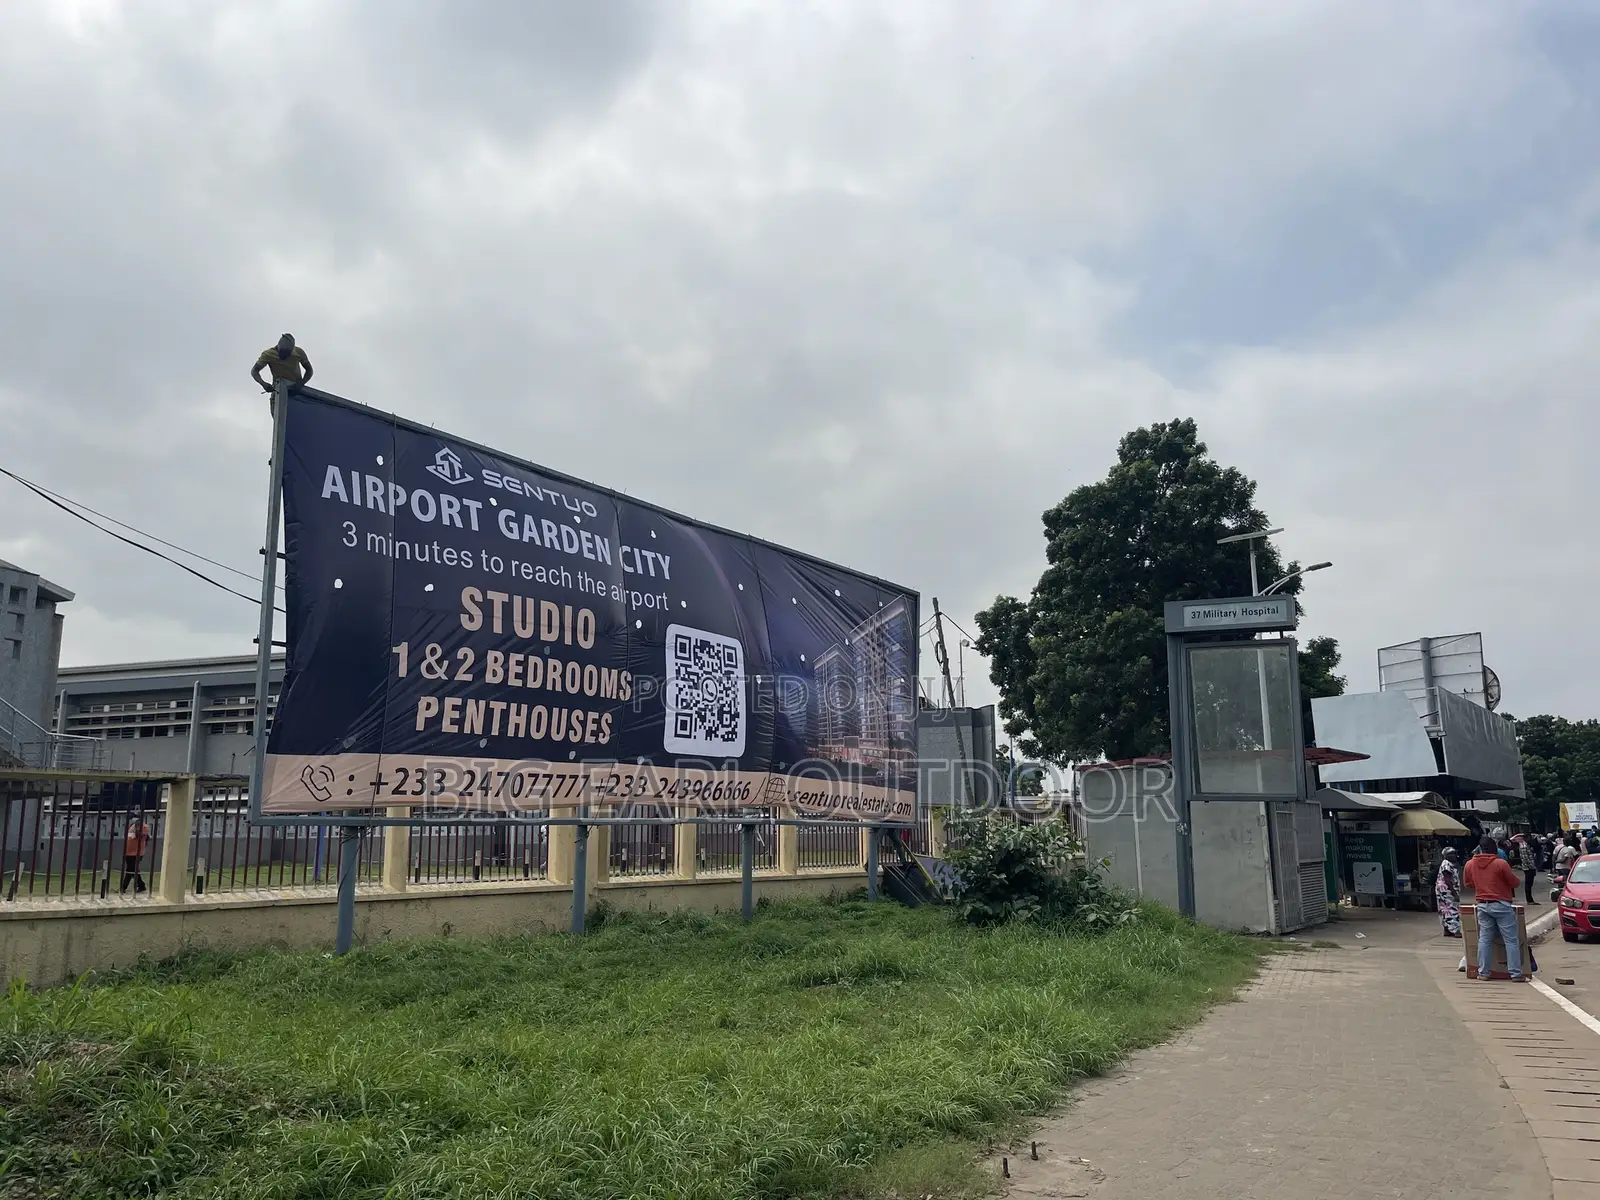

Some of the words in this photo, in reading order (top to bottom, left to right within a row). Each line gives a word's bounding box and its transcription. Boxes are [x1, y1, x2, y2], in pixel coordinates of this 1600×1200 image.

[481, 469, 598, 518] SENTUO
[321, 465, 482, 532] AIRPORT
[498, 508, 612, 566] GARDEN
[620, 545, 671, 580] CITY
[342, 520, 358, 548] 3
[366, 530, 474, 569] minutes
[482, 550, 504, 574] to
[512, 557, 572, 589] reach
[577, 571, 607, 597] the
[610, 582, 670, 612] airport
[460, 586, 596, 650] STUDIO
[1203, 609, 1238, 619] Military
[1241, 606, 1279, 617] Hospital
[392, 641, 409, 678] 1
[485, 649, 632, 702] BEDROOMS
[415, 696, 613, 745] PENTHOUSES
[369, 767, 447, 796] +233
[459, 769, 592, 799] 247077777
[595, 773, 648, 798] +233
